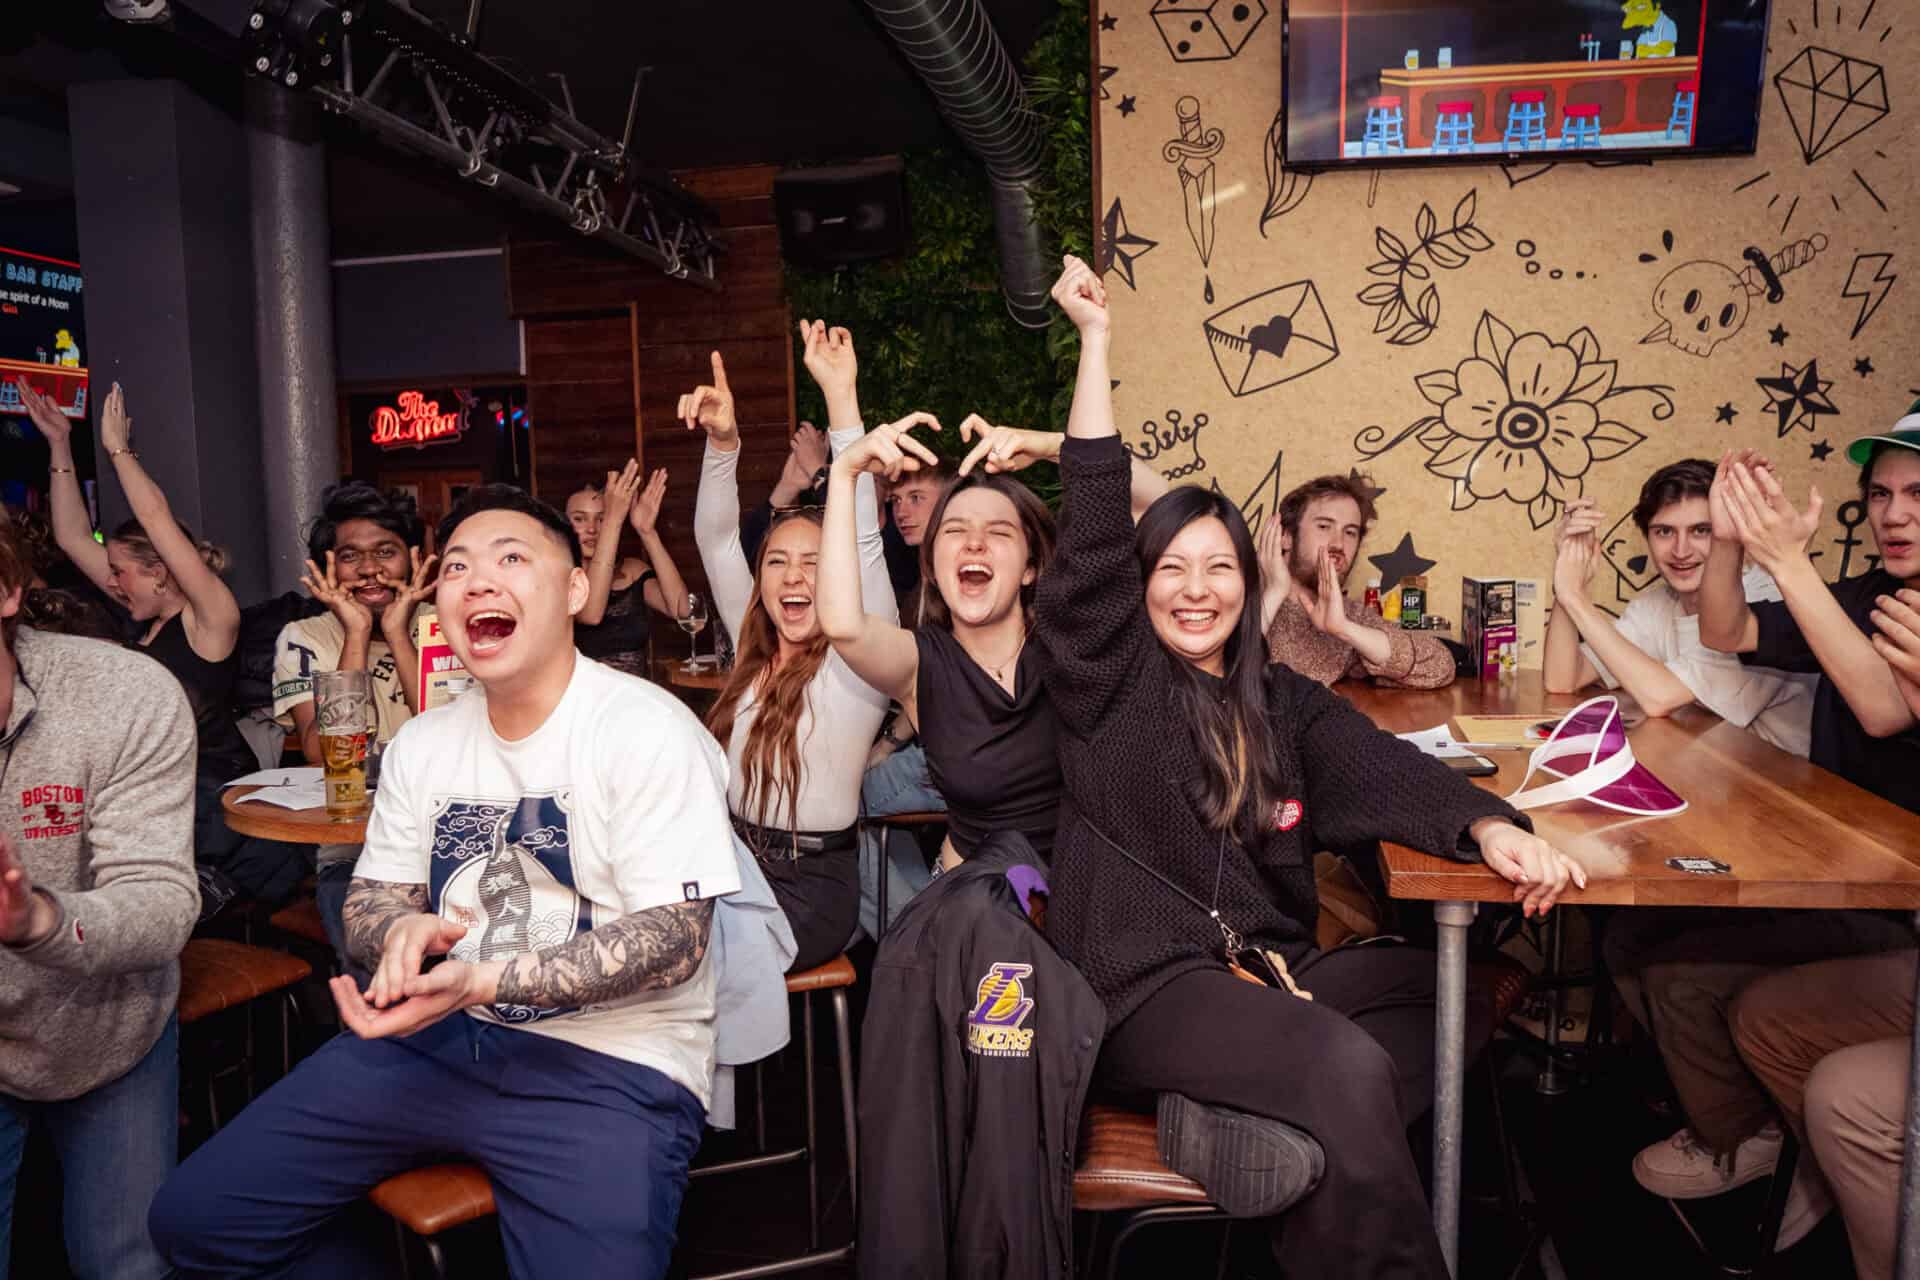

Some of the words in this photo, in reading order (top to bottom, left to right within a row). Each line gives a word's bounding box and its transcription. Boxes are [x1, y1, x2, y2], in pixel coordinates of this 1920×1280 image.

[6, 264, 36, 284] BAR
[41, 271, 82, 292] STAFF
[398, 391, 440, 421] The
[1403, 595, 1420, 608] HP
[22, 784, 84, 808] BOSTON
